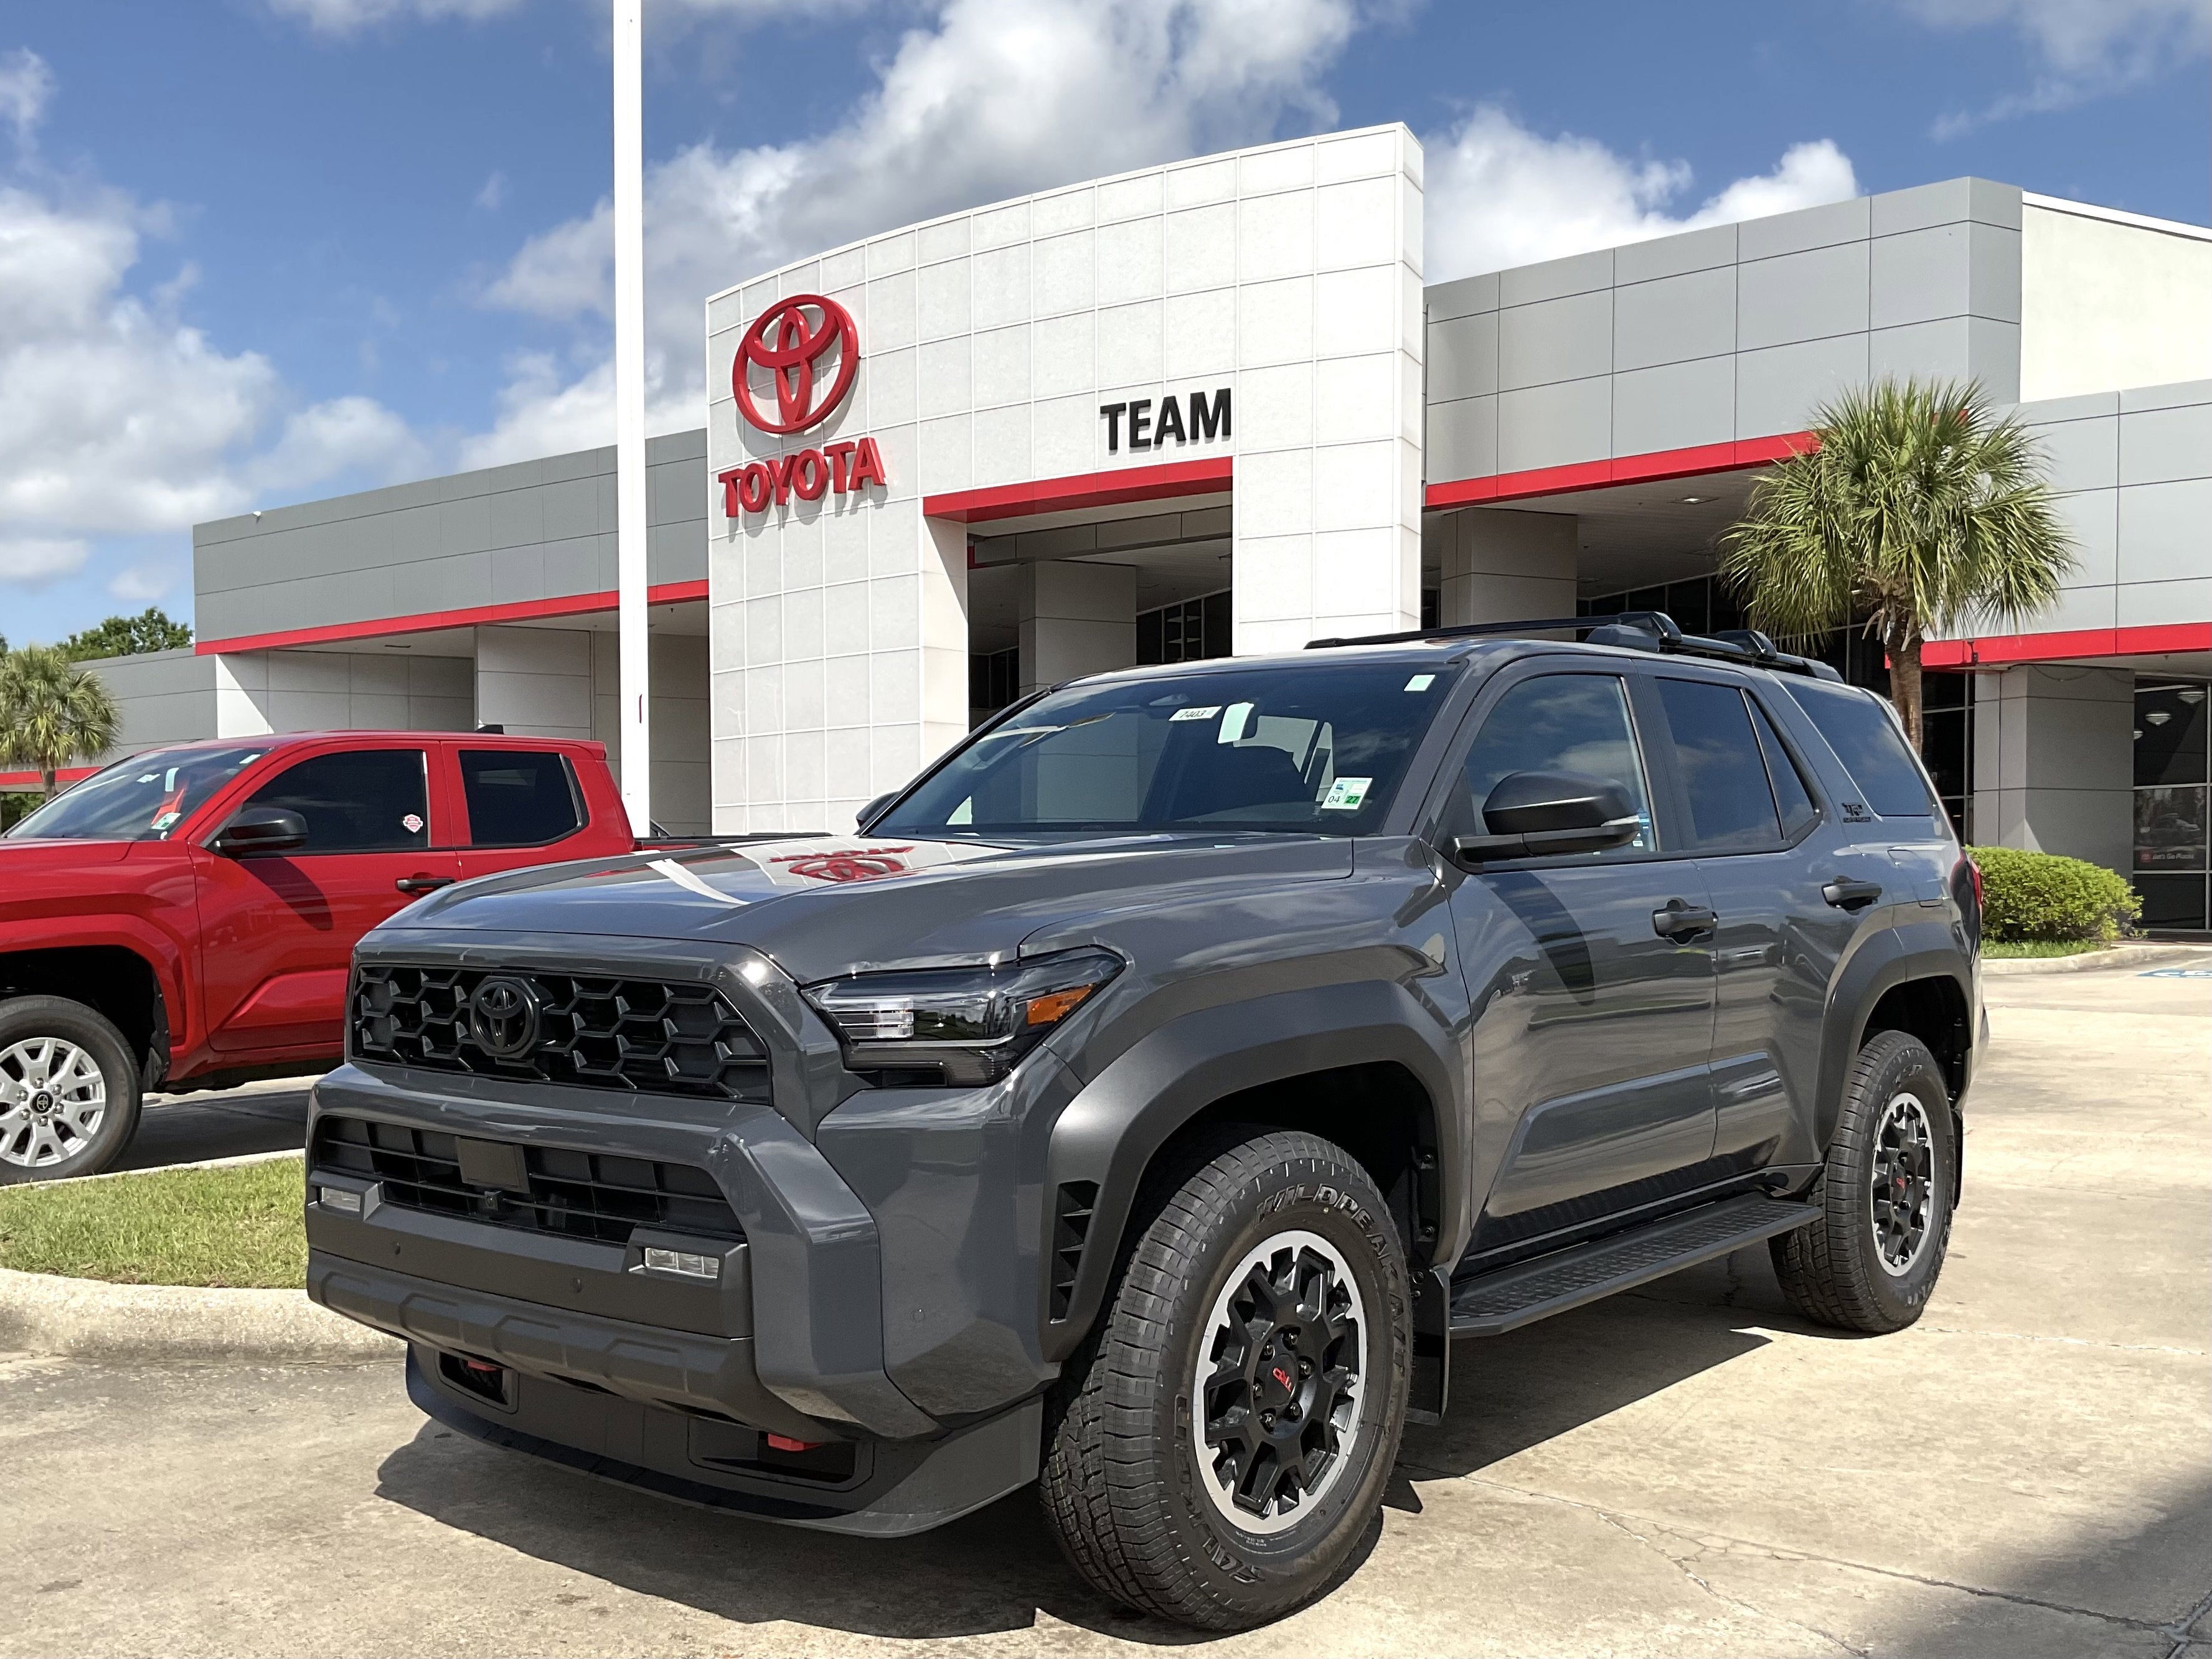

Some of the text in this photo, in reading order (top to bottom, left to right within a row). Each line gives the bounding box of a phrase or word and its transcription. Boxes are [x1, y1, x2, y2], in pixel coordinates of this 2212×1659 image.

[1099, 388, 1231, 450] TEAM
[718, 437, 887, 518] TOYOTA
[1345, 796, 1361, 804] 27
[1253, 1183, 1399, 1280] WILDPEAK
